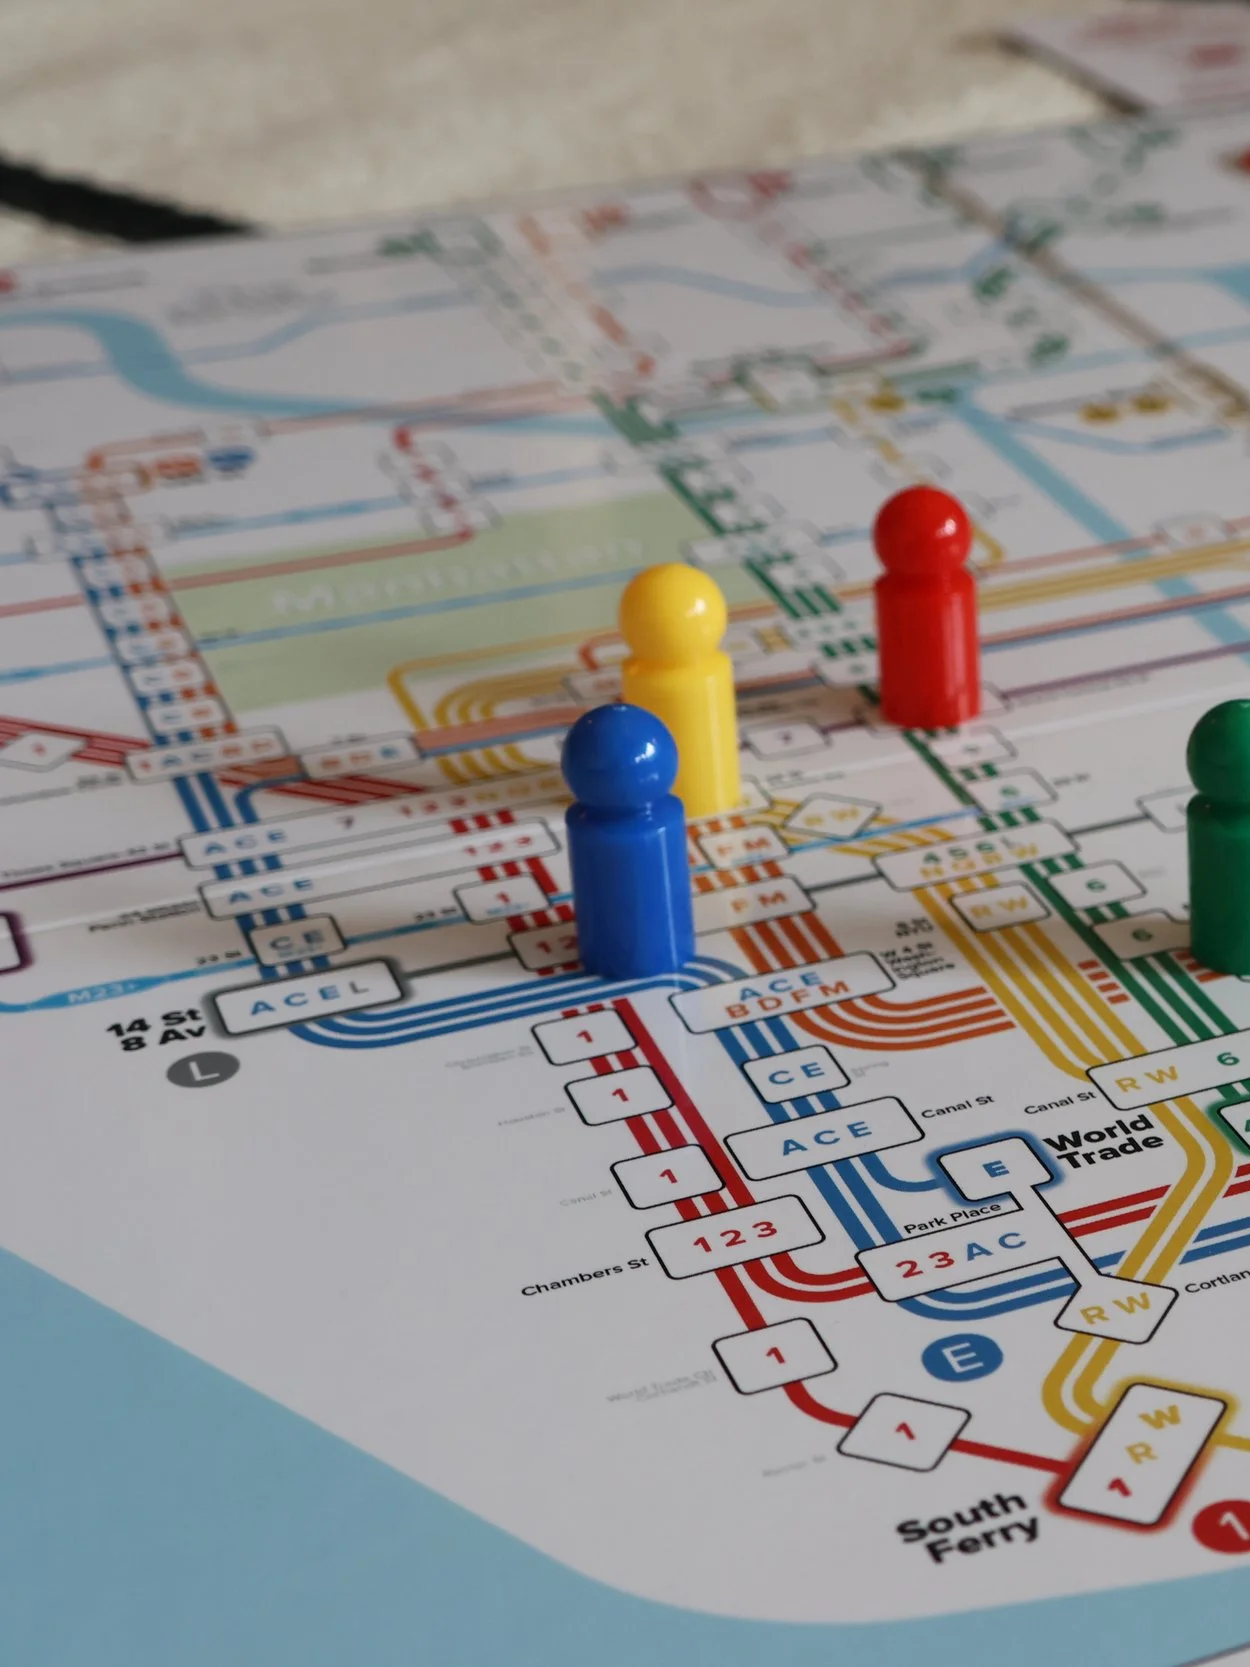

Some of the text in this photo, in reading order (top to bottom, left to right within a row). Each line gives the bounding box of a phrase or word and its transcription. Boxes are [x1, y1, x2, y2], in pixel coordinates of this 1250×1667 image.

[739, 971, 822, 1001] ACE
[106, 1008, 202, 1038] 14 St
[121, 1026, 206, 1051] 8 Av
[577, 1030, 592, 1043] 1
[188, 1060, 220, 1082] L
[1216, 1052, 1240, 1066] 6
[768, 1061, 825, 1085] CE
[612, 1088, 629, 1102] 1
[921, 1094, 994, 1119] Canal St
[1023, 1090, 1097, 1116] Canal St
[782, 1121, 872, 1156] ACE
[1042, 1114, 1155, 1152] World
[1056, 1133, 1165, 1170] Trade
[659, 1168, 677, 1184] 1
[982, 1160, 1010, 1178] E
[903, 1203, 1002, 1235] Park Place
[520, 1256, 649, 1297] Chambers St
[765, 1346, 786, 1365] 1
[941, 1342, 984, 1374] E
[1139, 1404, 1182, 1430] W
[895, 1421, 917, 1442] 1
[1125, 1441, 1159, 1465] R
[1107, 1477, 1132, 1498] 1
[895, 1493, 1028, 1544] South
[925, 1515, 1039, 1564] Ferry
